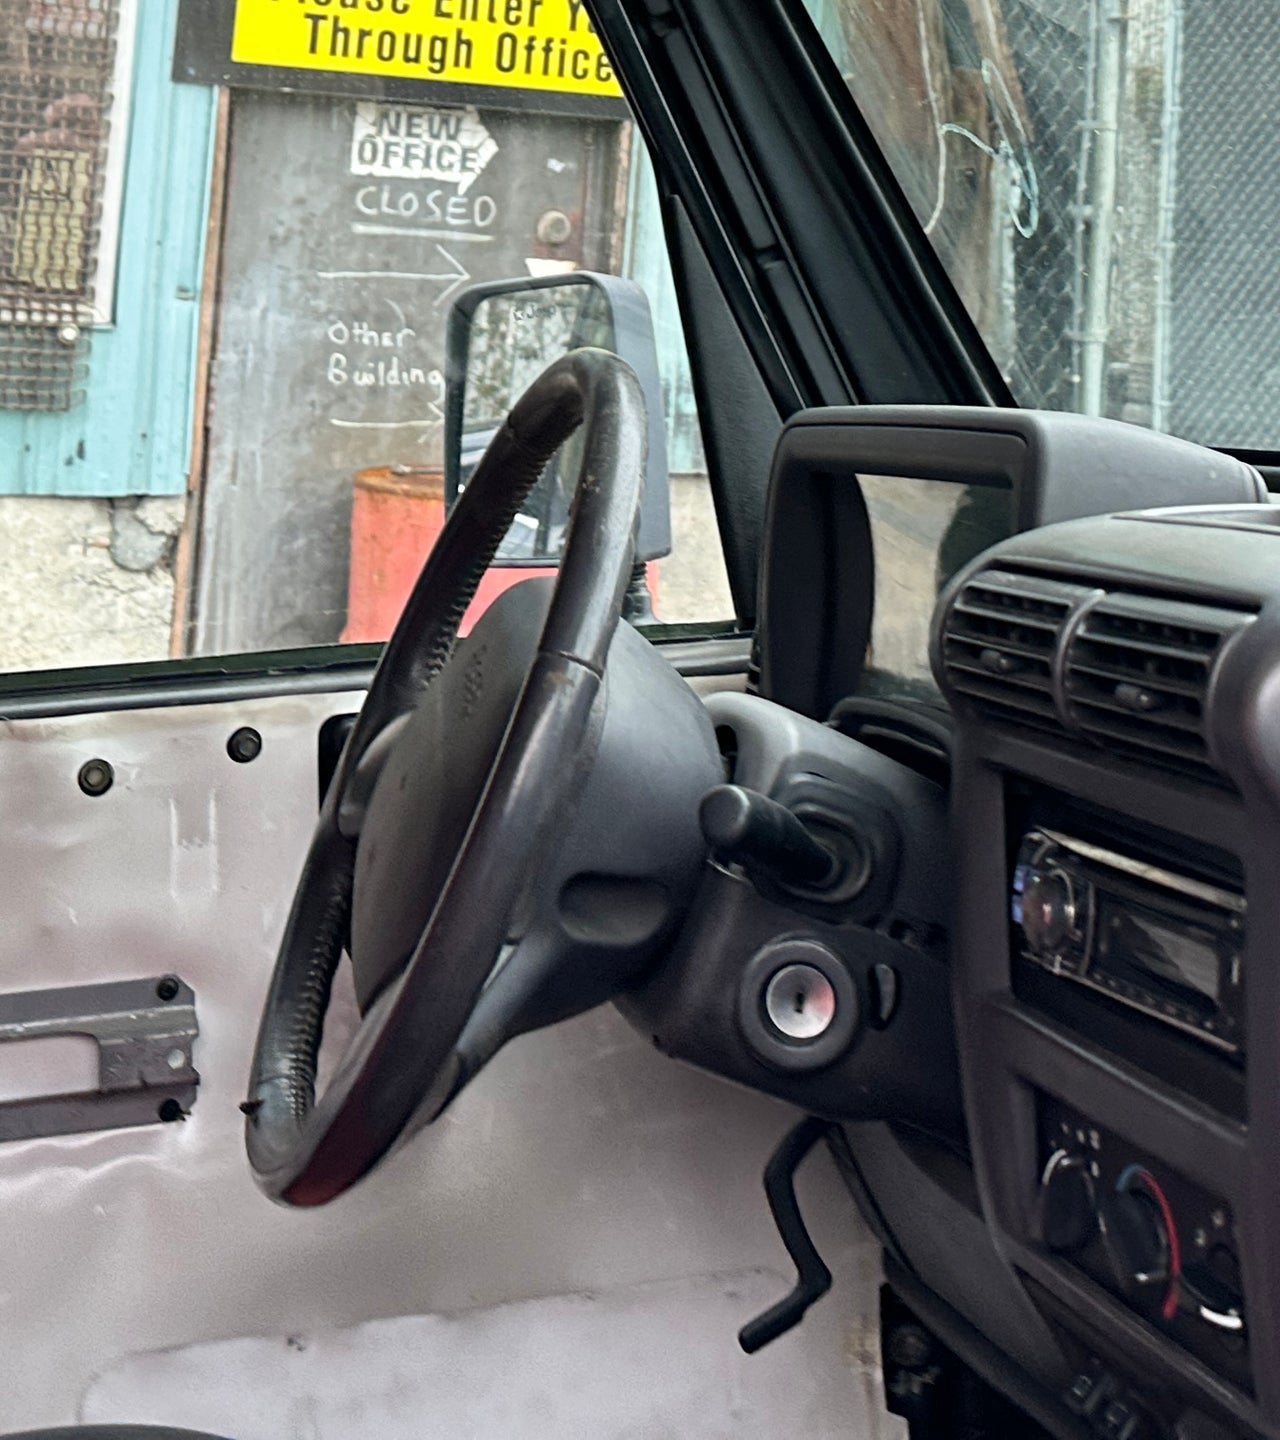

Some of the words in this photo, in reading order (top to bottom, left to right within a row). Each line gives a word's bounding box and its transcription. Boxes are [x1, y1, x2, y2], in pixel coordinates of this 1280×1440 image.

[304, 12, 472, 75] Through
[495, 32, 612, 83] Office
[377, 111, 462, 141] NEW
[357, 134, 481, 173] OFFICE
[355, 185, 497, 227] CLOSED
[327, 320, 416, 348] Other
[327, 352, 446, 406] Building
